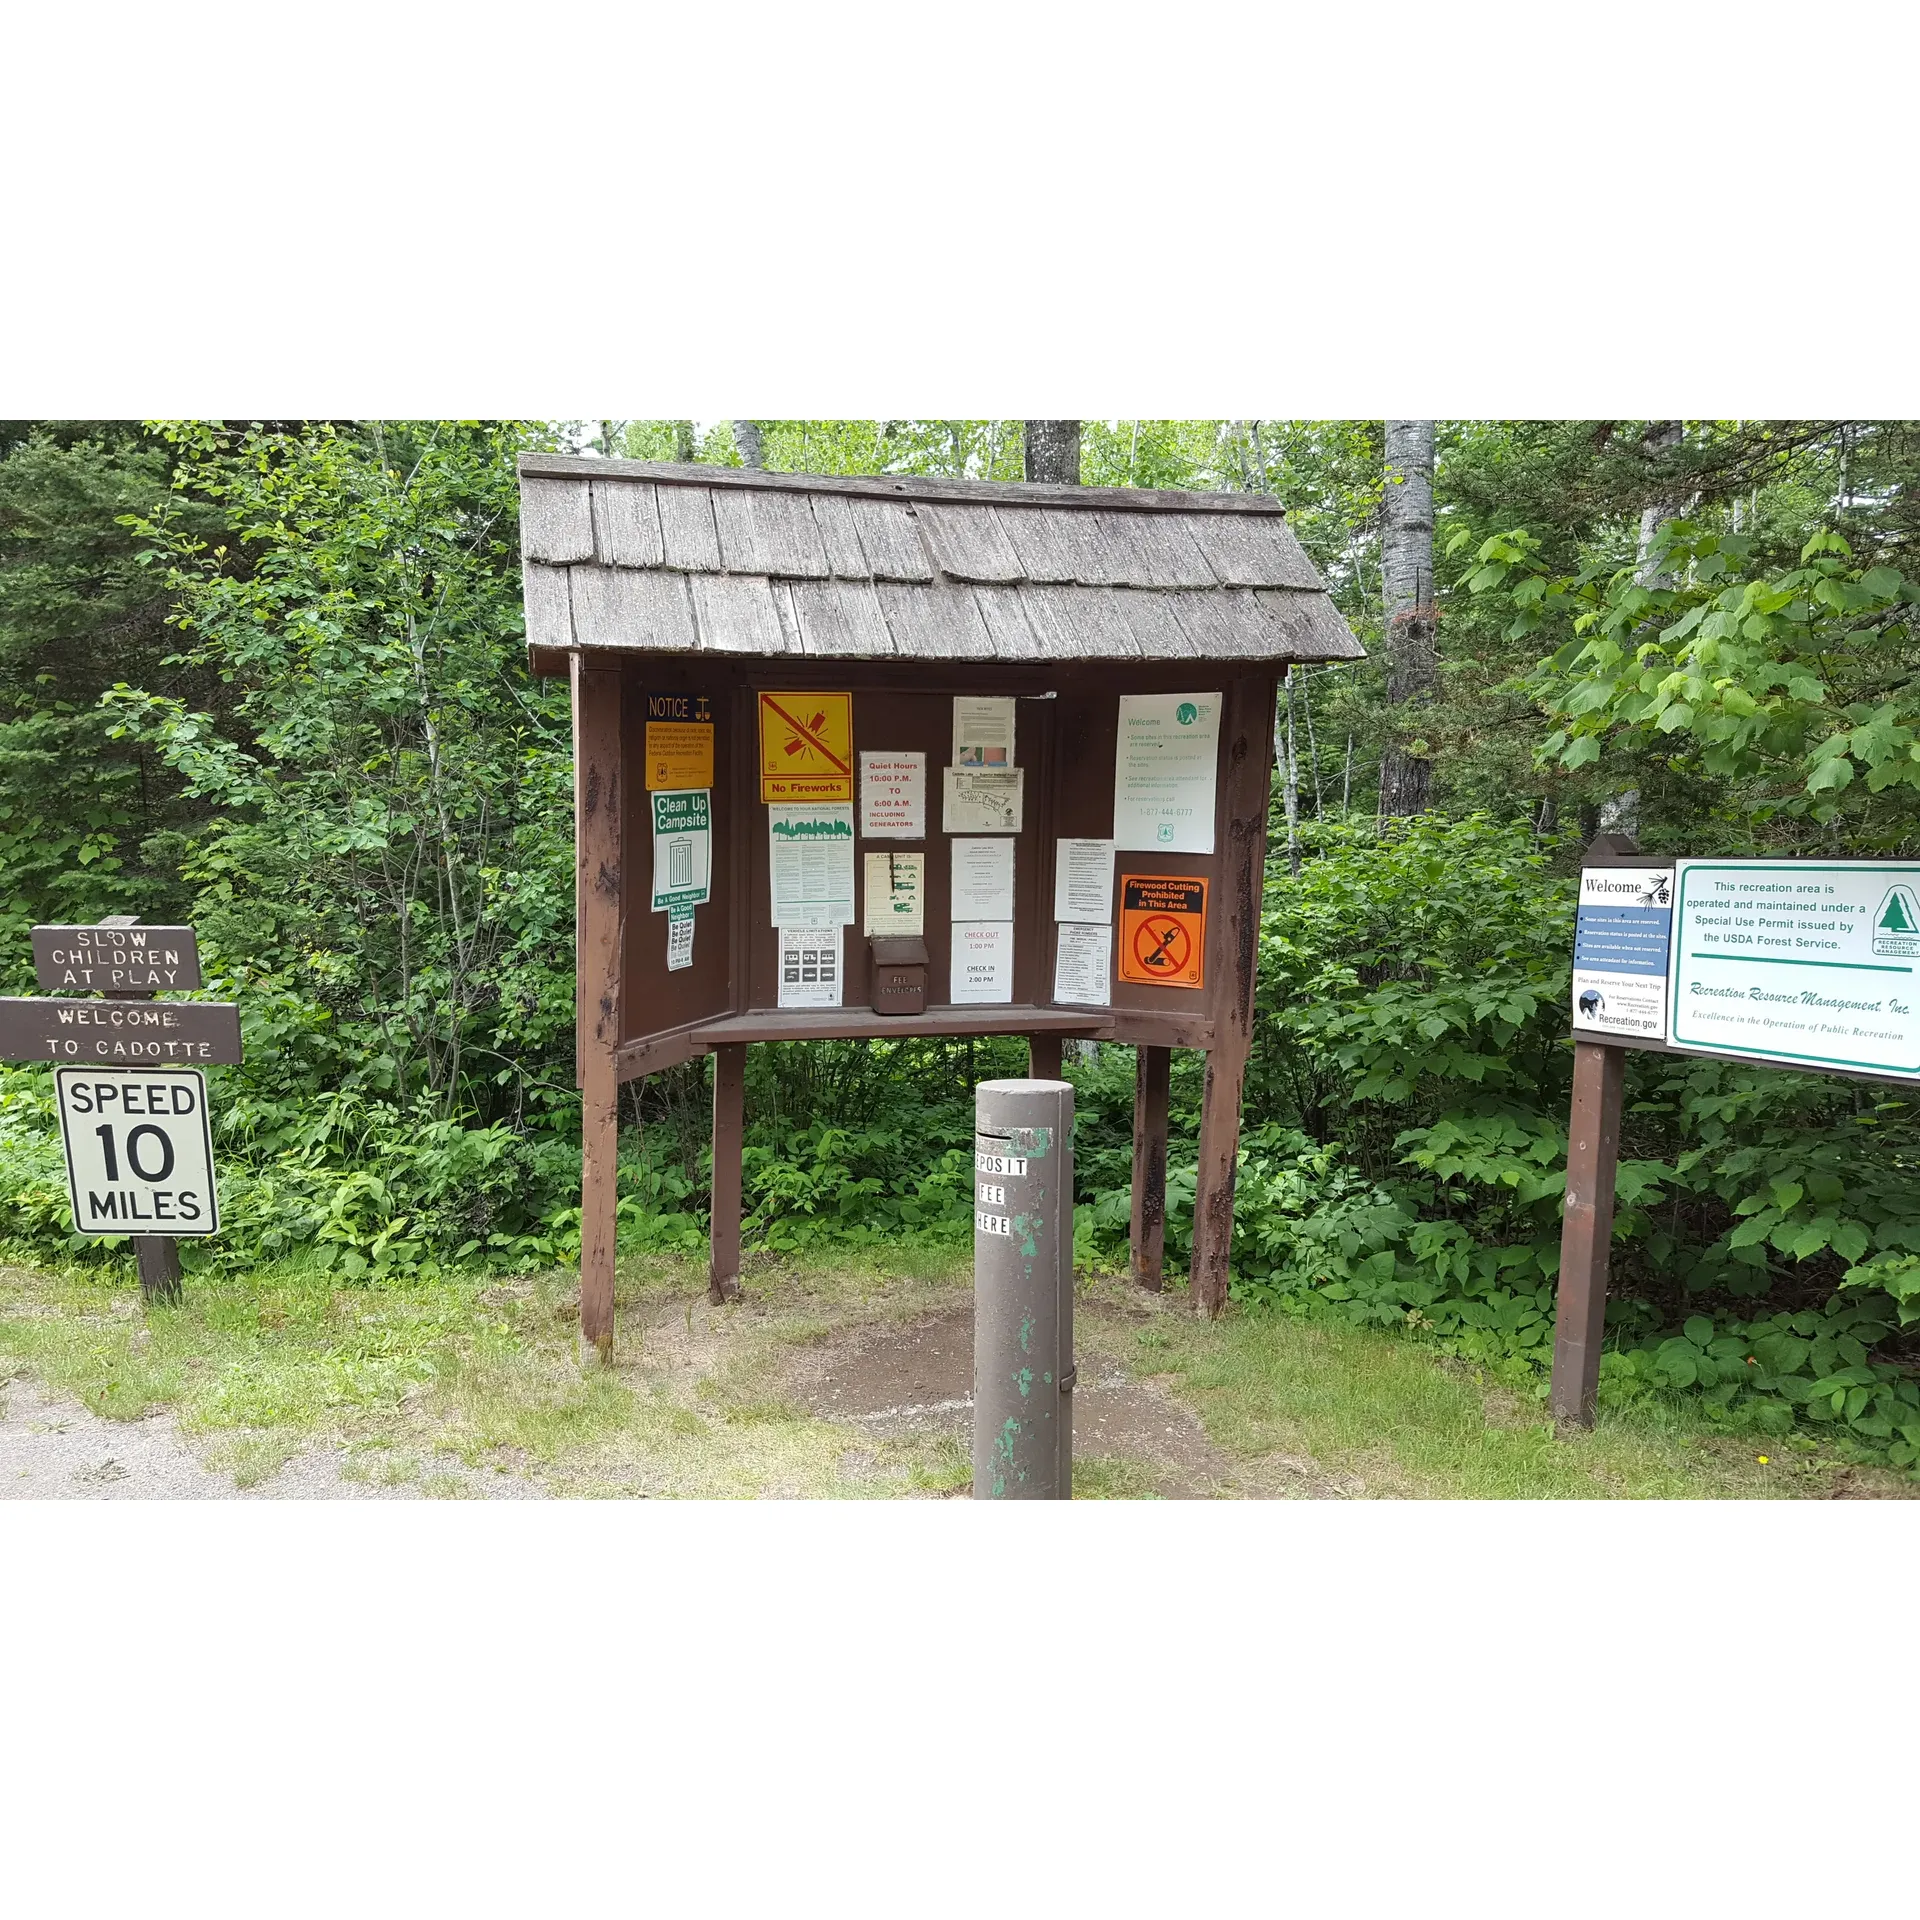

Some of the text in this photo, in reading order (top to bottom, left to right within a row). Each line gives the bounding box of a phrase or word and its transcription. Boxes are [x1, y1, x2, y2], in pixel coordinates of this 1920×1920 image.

[649, 697, 688, 717] NOTICE
[1128, 718, 1160, 726] Welcome
[772, 782, 842, 792] No Fireworks
[657, 796, 707, 814] Clean Up
[1140, 808, 1193, 816] 1-877-444-6777
[658, 813, 708, 830] Campsite
[1129, 880, 1200, 893] Firewood Cutting
[1586, 879, 1642, 894] Welcome
[1714, 882, 1834, 894] This recreation area is
[682, 892, 700, 900] Neighbor
[1142, 890, 1186, 900] Prohibited
[680, 904, 692, 912] Good
[1138, 900, 1188, 910] in This Area
[1686, 900, 1866, 914] operated and maintained under a
[670, 912, 690, 920] Neighbor
[1695, 916, 1854, 933] Special Use Permit issued by
[78, 932, 148, 948] SLOW
[1704, 933, 1841, 950] the USDA Forest Service.
[52, 950, 180, 966] CHILDREN
[63, 969, 178, 985] AT PLAY
[894, 976, 907, 984] FEE
[1578, 976, 1589, 984] Plan
[1622, 980, 1634, 988] Your
[1649, 983, 1662, 991] Trip
[1689, 982, 1746, 998] Recreation
[1748, 987, 1798, 1004] Resource
[57, 1009, 176, 1026] WELCOME
[1598, 1014, 1658, 1030] Recreation.gov
[1692, 1010, 1904, 1041] Excellence in the Operation of Public Recreation
[46, 1039, 212, 1058] TO CADOTTE
[70, 1082, 196, 1116] SPEED
[96, 1123, 175, 1182] 10
[976, 1153, 1026, 1174] EPOSIT
[980, 1184, 1002, 1203] FEE
[89, 1191, 201, 1221] MILES
[977, 1212, 1008, 1234] HERE
